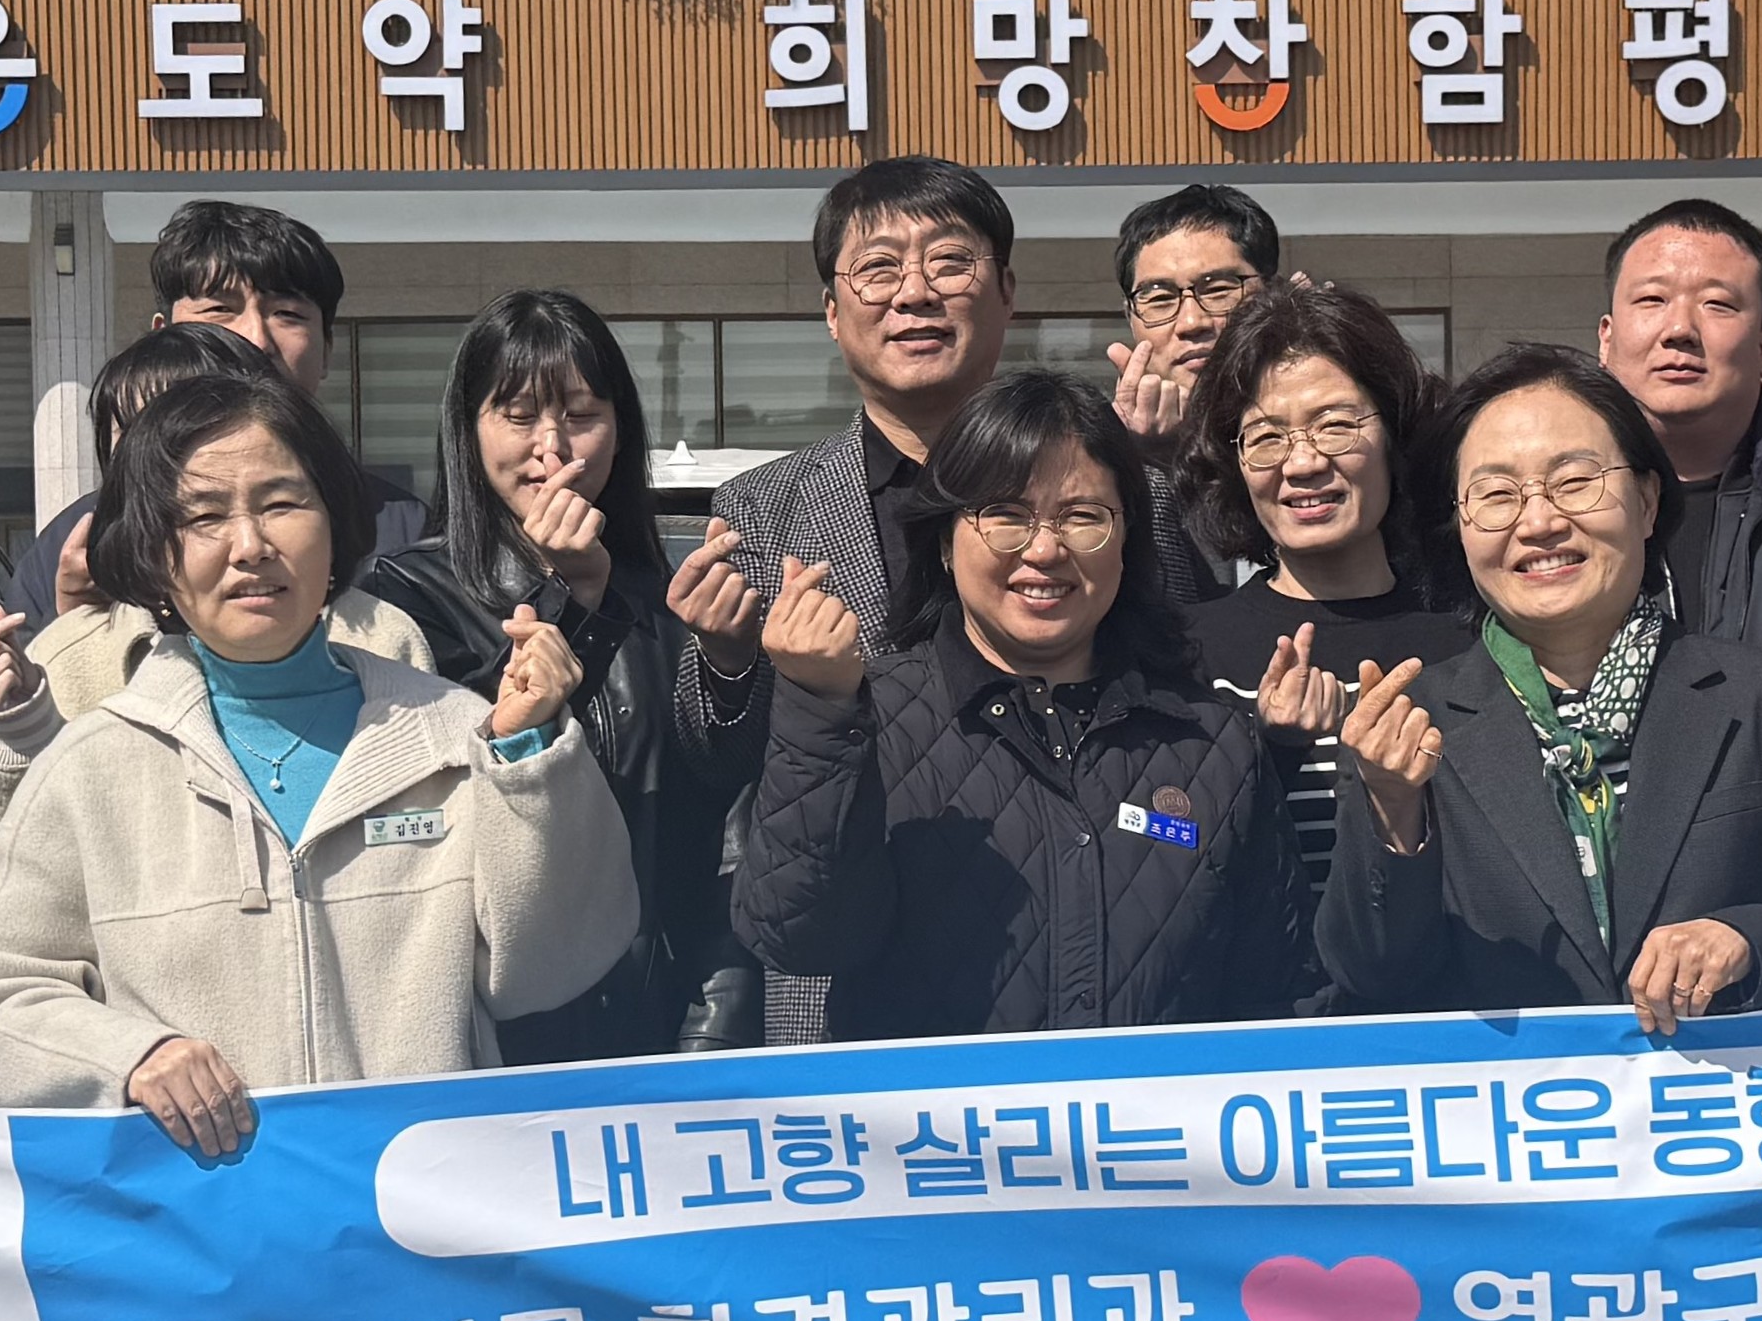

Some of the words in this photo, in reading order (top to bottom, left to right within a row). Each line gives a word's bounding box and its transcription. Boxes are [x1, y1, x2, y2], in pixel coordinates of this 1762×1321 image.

[552, 1123, 648, 1218] 내
[675, 1114, 869, 1208] 고향
[896, 1102, 1189, 1198] 살리는
[1220, 1078, 1619, 1189] 아름다운
